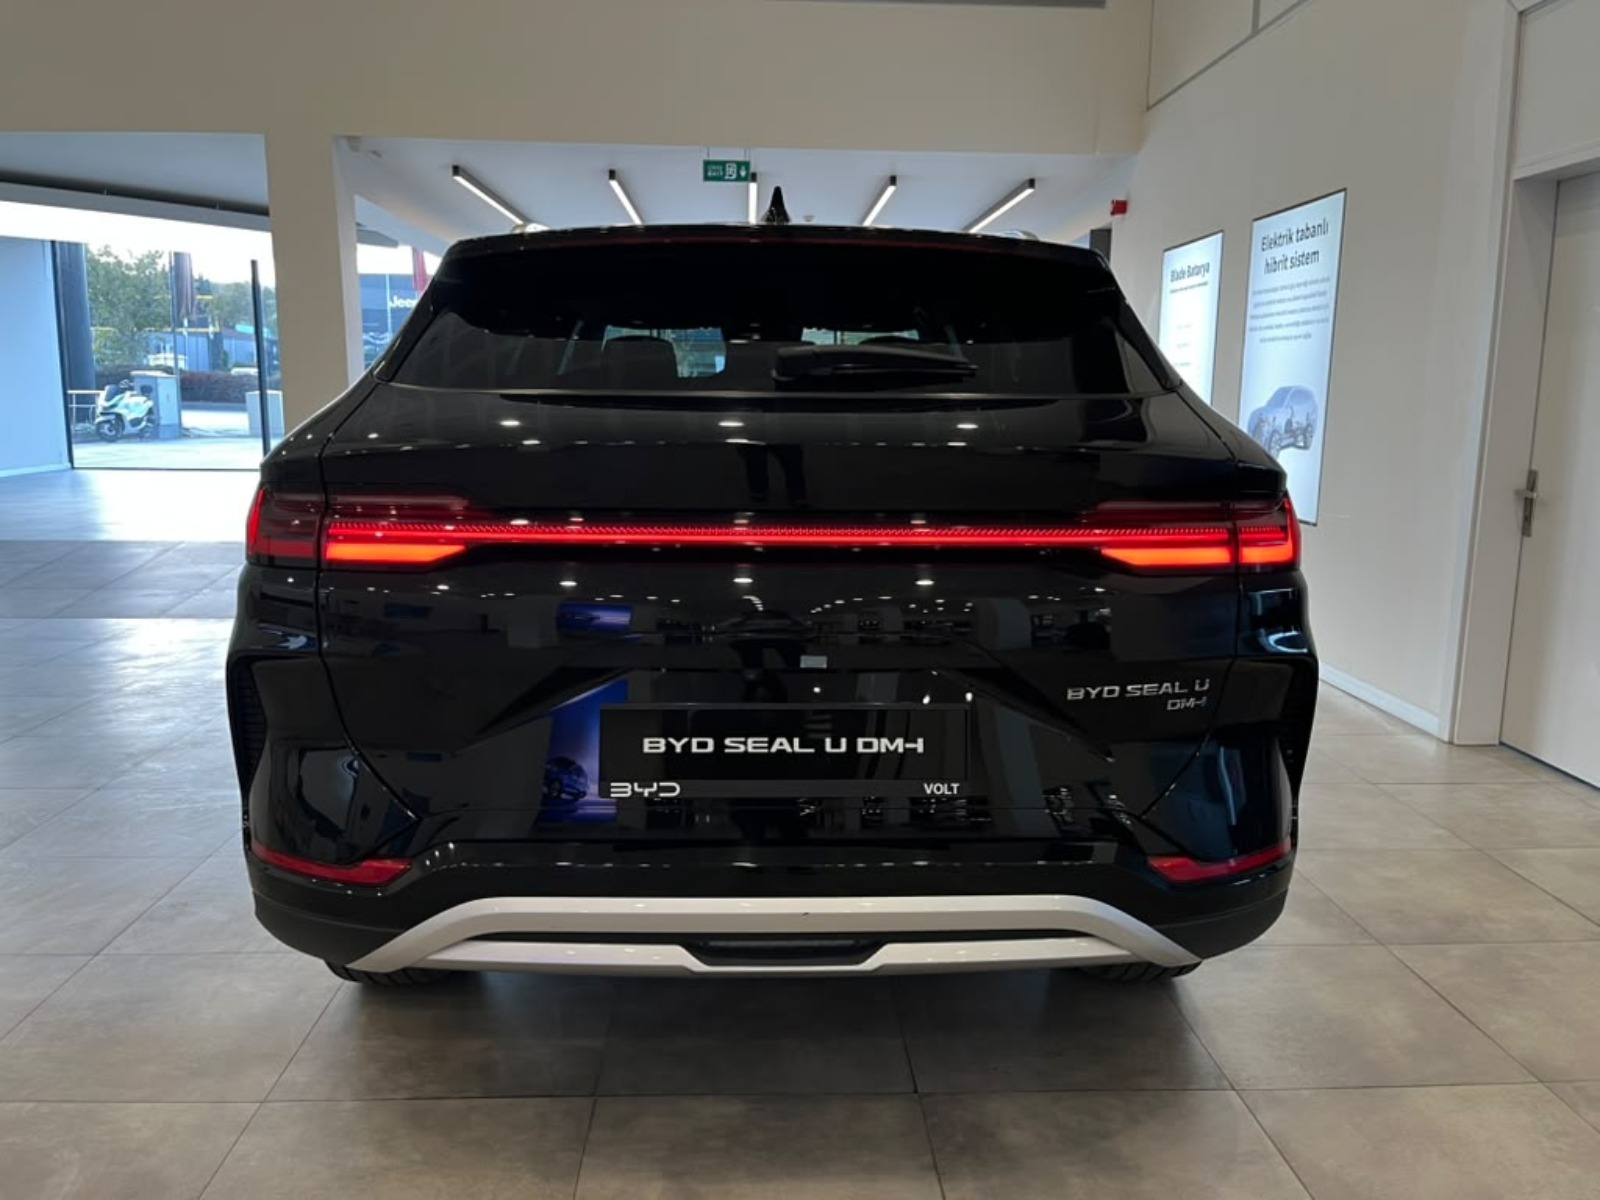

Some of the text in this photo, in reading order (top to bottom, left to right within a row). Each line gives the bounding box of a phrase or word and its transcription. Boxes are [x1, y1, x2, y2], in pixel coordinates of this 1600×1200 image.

[1261, 217, 1329, 252] Elektrik tabanlı
[1264, 249, 1320, 275] hibrit sistem
[1066, 678, 1210, 700] BYD SEAL U
[643, 737, 715, 753] BYD
[724, 737, 815, 753] SEAL
[824, 737, 847, 753] U
[609, 782, 681, 798] BYD
[923, 783, 960, 795] VOLT
